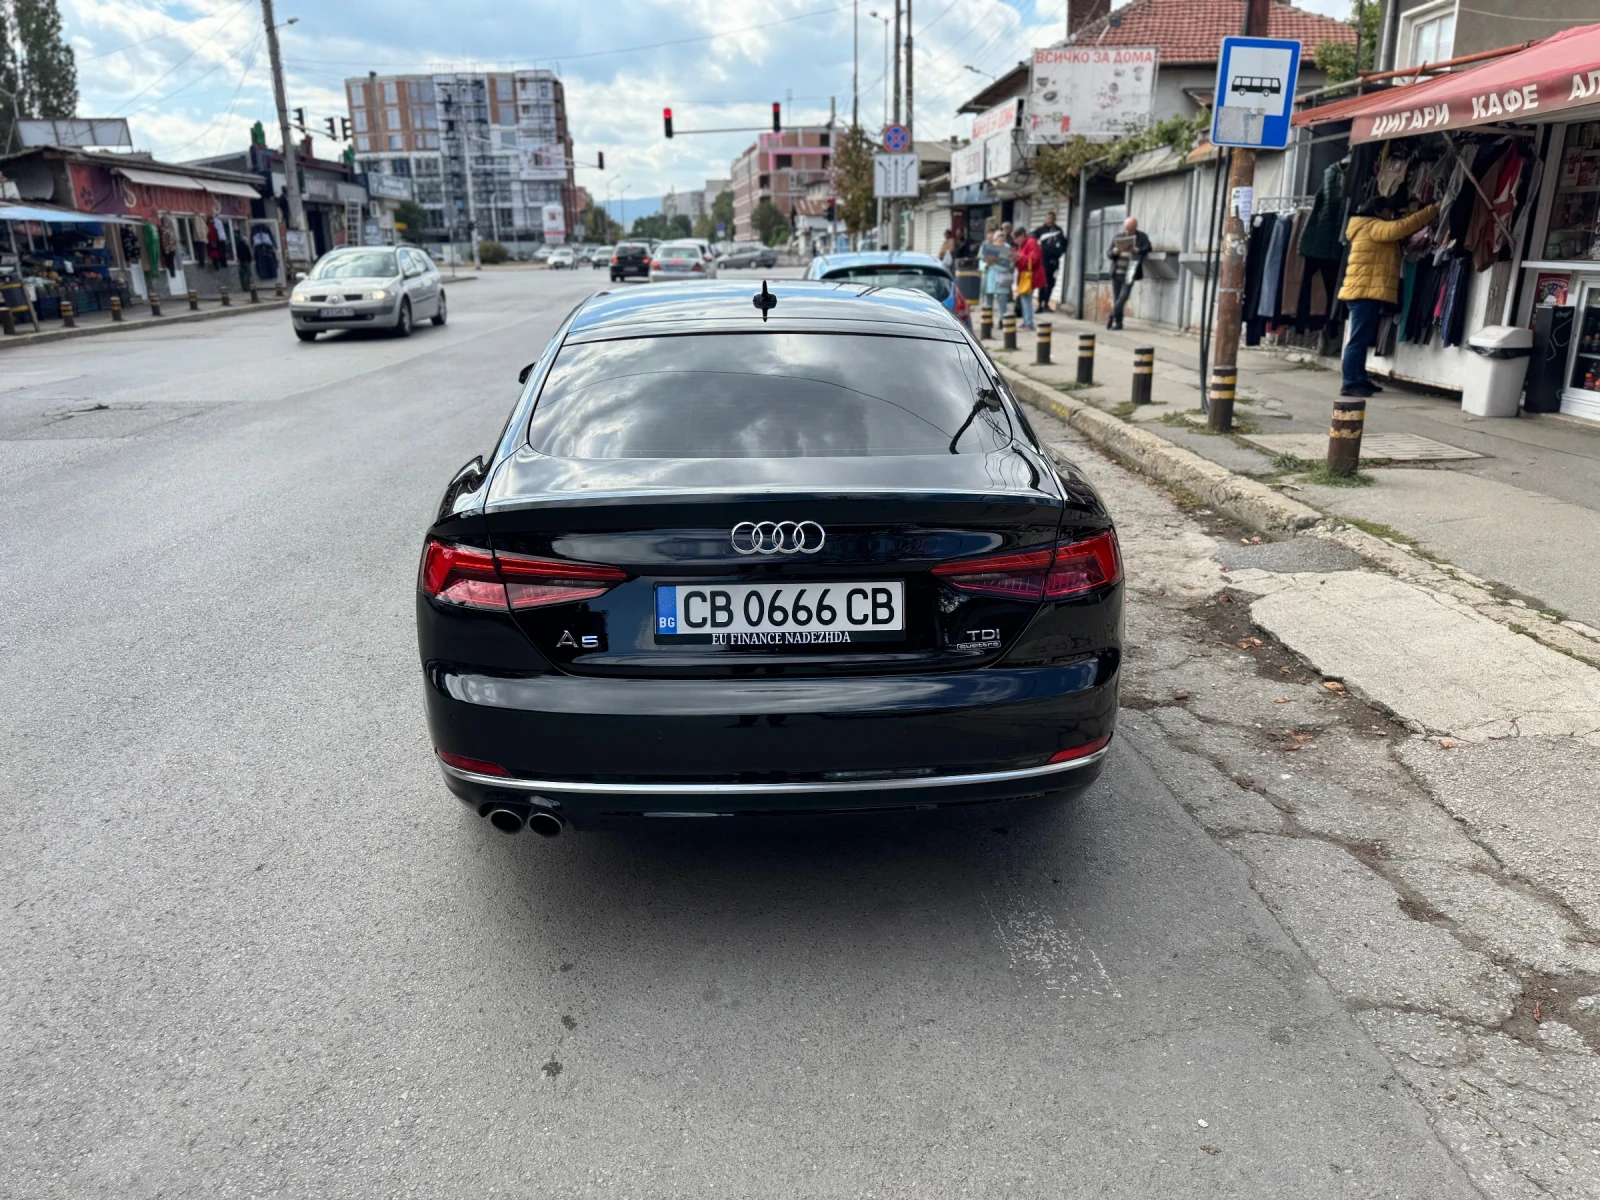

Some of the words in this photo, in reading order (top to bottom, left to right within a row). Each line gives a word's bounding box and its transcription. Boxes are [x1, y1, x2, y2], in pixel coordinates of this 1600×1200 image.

[1035, 51, 1090, 64] ВСИЧКО
[1093, 51, 1110, 63] ЗА
[1113, 51, 1153, 65] ДОМА
[1370, 103, 1450, 137] ЦИГАРИ
[1471, 84, 1539, 119] КАФЕ
[683, 590, 734, 628] CB
[743, 588, 837, 627] 0666
[846, 588, 895, 625] CB
[659, 617, 676, 628] BG
[556, 630, 599, 648] A5
[712, 633, 728, 645] EU
[731, 632, 783, 645] FINANCE
[785, 631, 851, 644] NADEZHDA
[966, 628, 1000, 641] TDI
